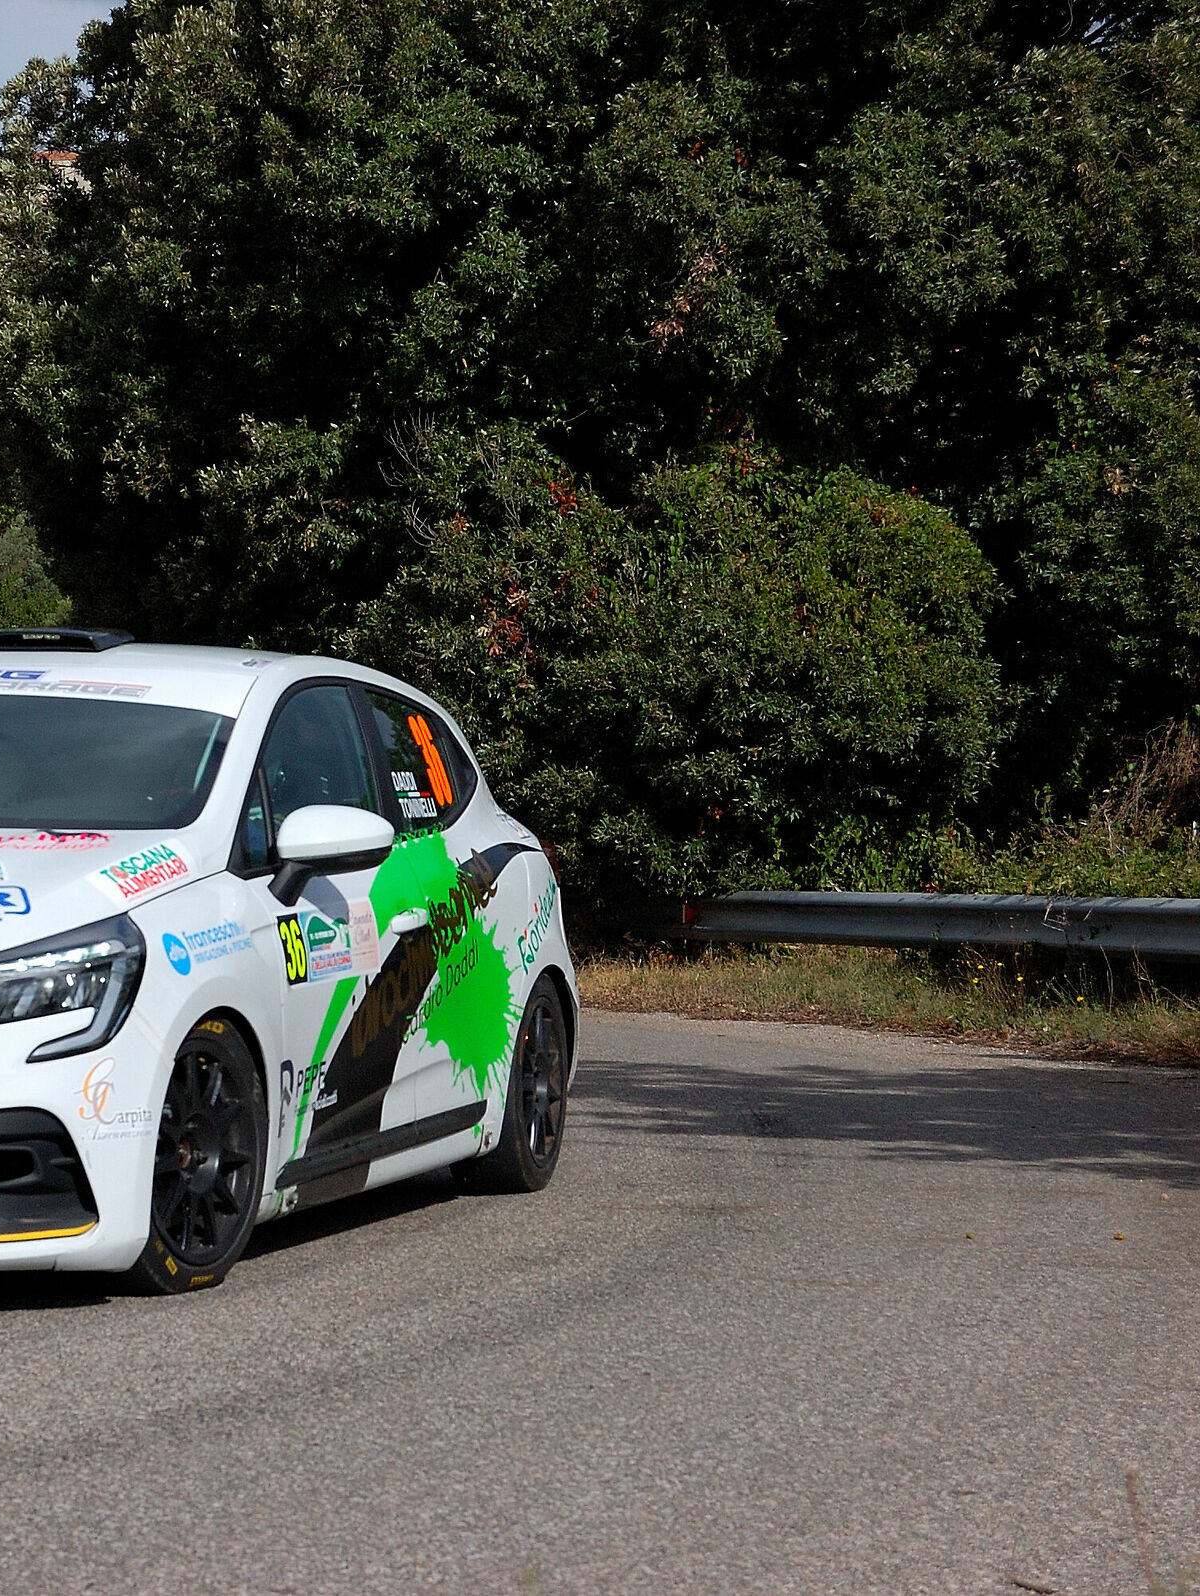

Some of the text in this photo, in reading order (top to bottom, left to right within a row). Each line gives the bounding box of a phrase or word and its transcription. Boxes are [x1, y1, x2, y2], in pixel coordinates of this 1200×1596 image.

[407, 714, 453, 807] 36
[117, 856, 188, 898] ALIMENTARI
[280, 919, 306, 981] 36
[446, 939, 480, 997] Daddi
